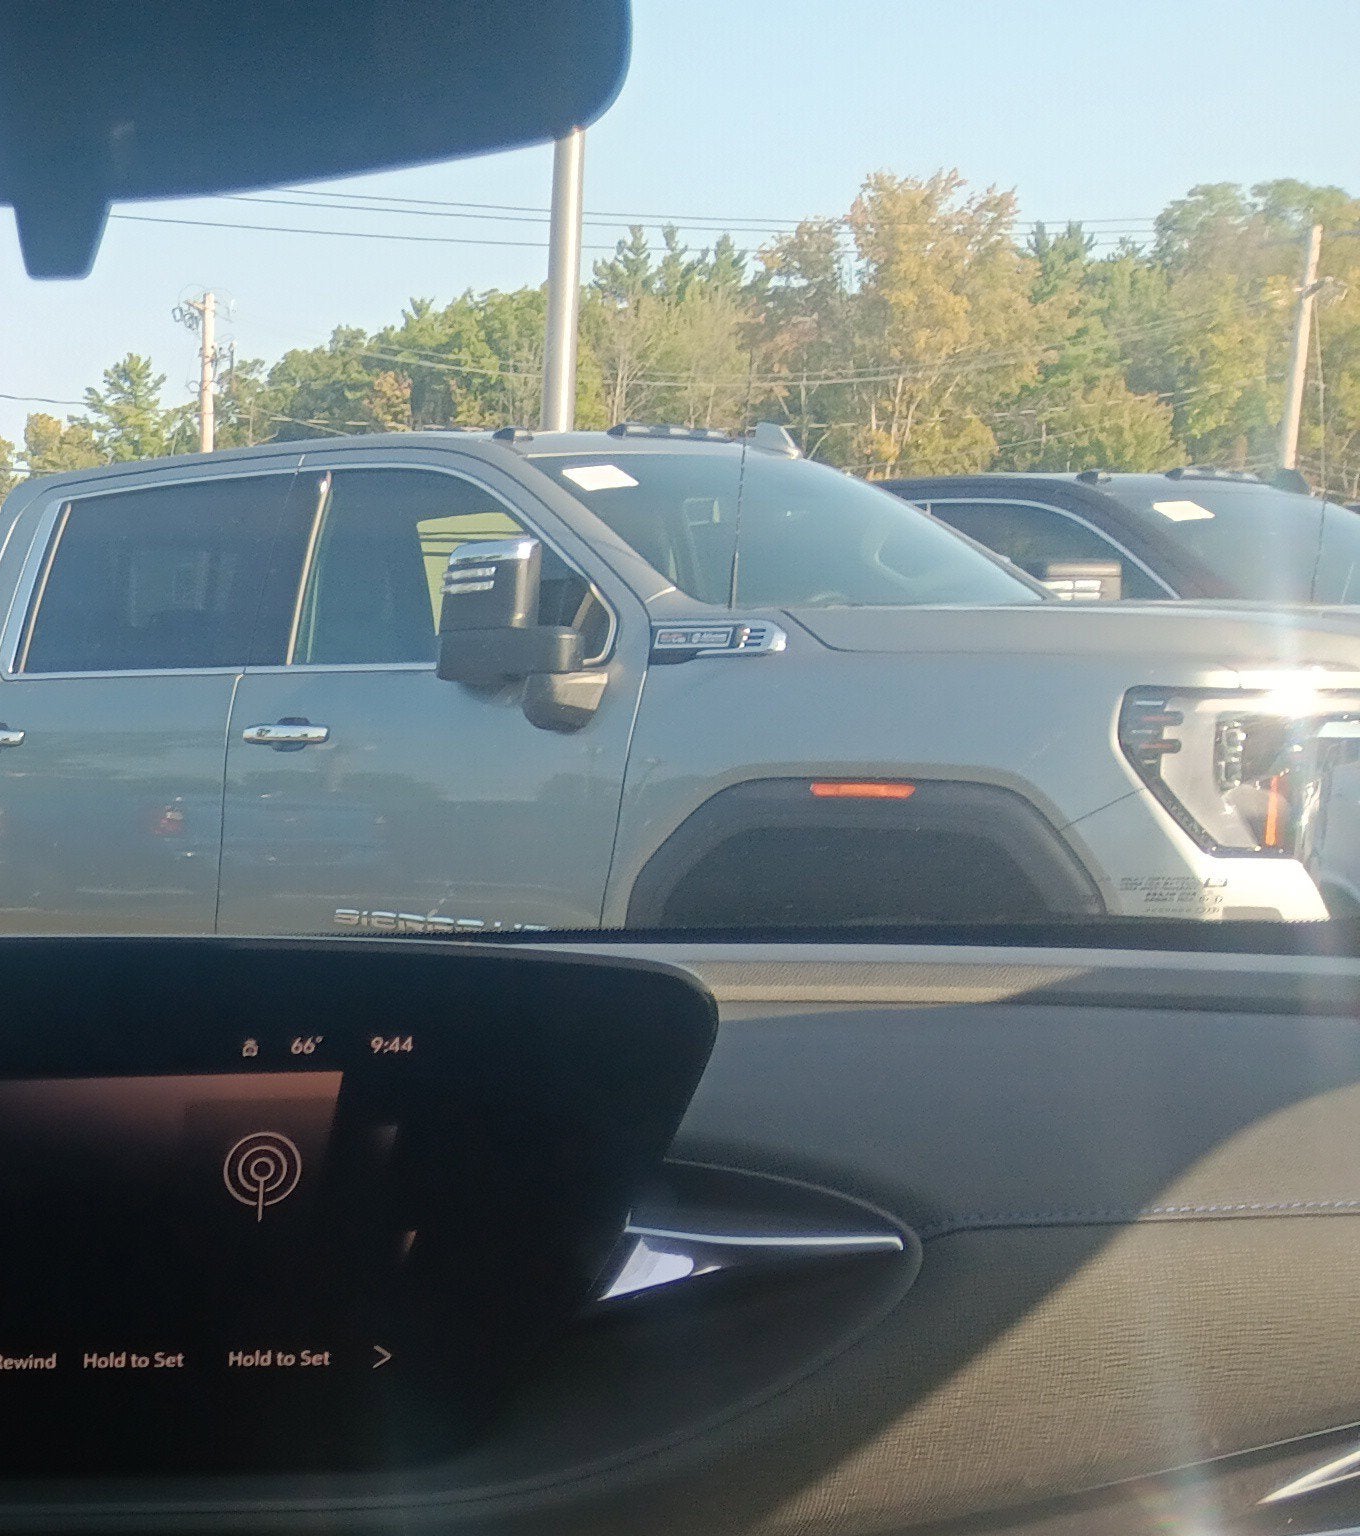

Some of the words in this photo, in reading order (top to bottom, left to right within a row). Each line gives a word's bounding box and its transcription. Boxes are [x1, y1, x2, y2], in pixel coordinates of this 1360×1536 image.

[370, 1036, 414, 1054] 9:44
[83, 1352, 126, 1369] Hold
[130, 1354, 149, 1369] to
[153, 1352, 185, 1369] Set
[228, 1350, 272, 1368] Hold
[276, 1351, 295, 1367] to
[299, 1350, 331, 1367] Set
